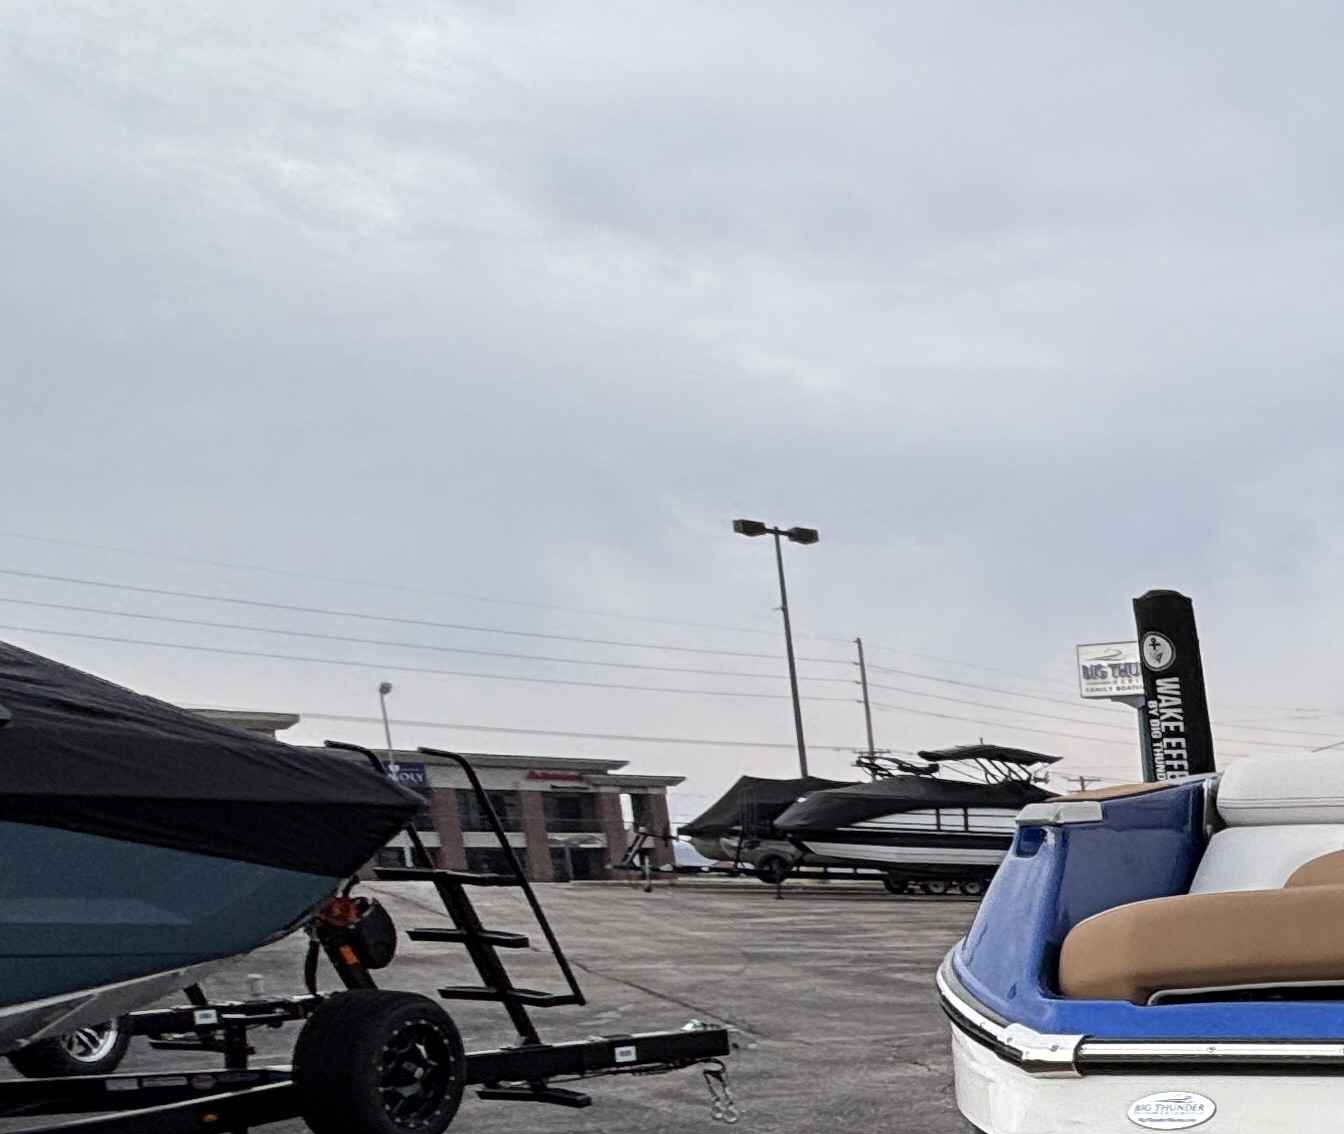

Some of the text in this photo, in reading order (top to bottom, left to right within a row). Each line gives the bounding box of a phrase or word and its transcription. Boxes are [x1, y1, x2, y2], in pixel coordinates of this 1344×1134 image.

[1108, 662, 1141, 679] THU
[1147, 700, 1160, 717] BY
[1155, 677, 1185, 733] WAKE
[1149, 719, 1163, 739] BIG
[1155, 1103, 1205, 1112] THUNDER
